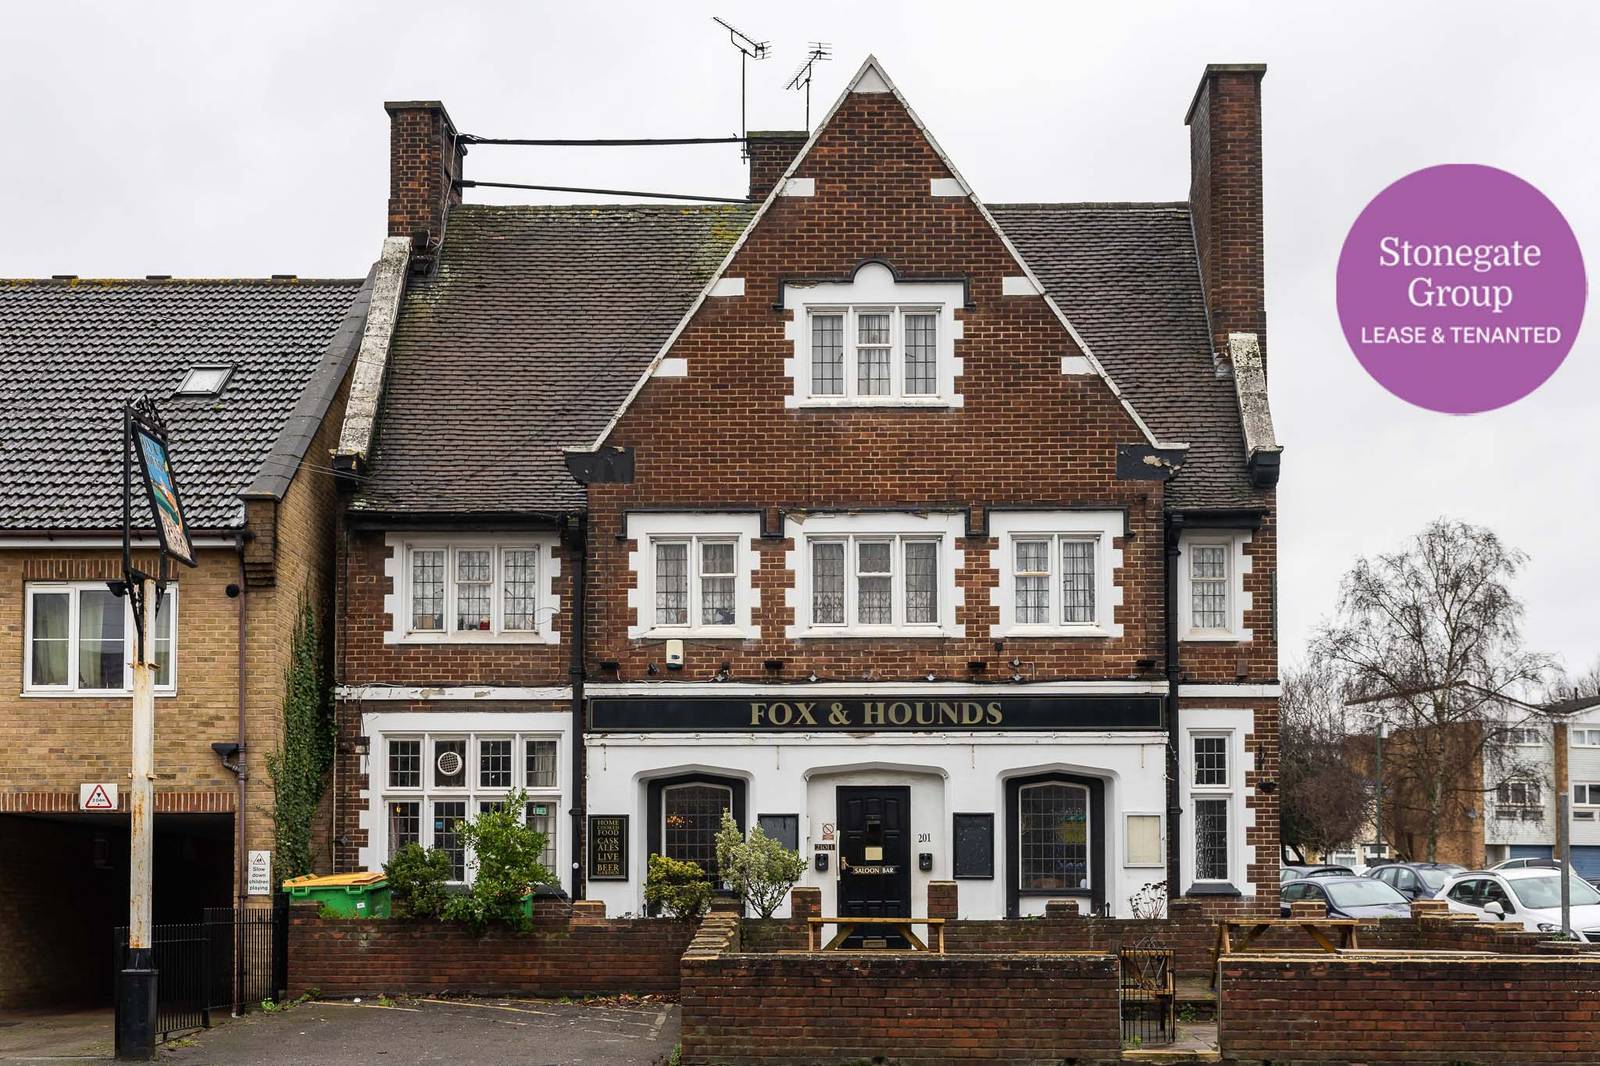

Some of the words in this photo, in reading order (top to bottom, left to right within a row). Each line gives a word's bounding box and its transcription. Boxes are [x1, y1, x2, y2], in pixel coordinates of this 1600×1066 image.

[750, 702, 818, 725] FOX
[828, 702, 852, 725] &
[863, 702, 1004, 725] HOUNDS
[918, 832, 931, 843] 201
[597, 853, 619, 861] LIVE
[597, 863, 619, 871] BEER
